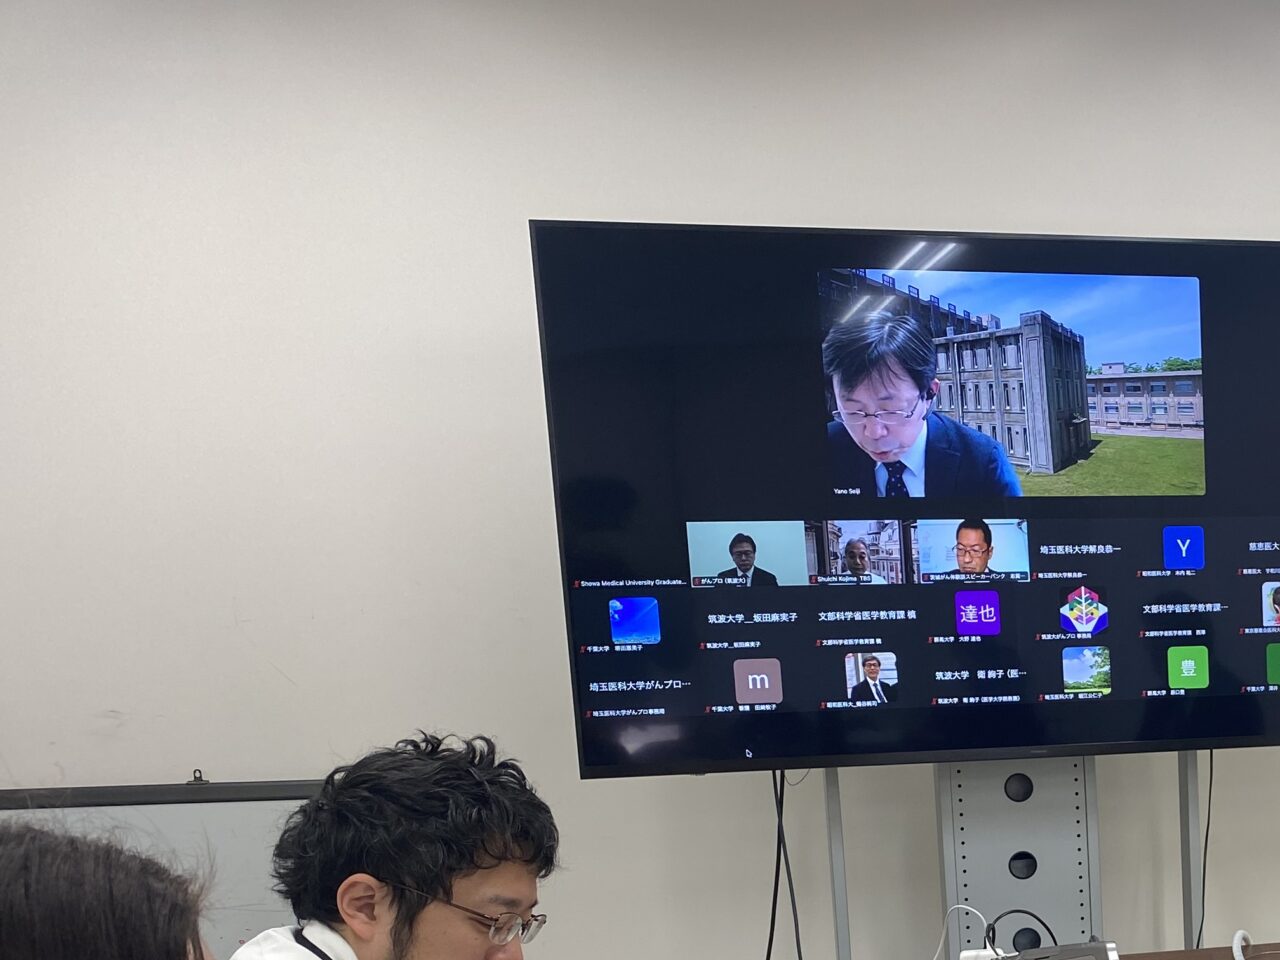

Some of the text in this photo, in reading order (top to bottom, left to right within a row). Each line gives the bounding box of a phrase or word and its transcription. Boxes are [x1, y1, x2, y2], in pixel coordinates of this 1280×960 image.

[1176, 539, 1191, 558] Y
[625, 579, 655, 587] University
[960, 604, 997, 623] 達也
[1180, 659, 1197, 677] 豊
[748, 673, 769, 689] m
